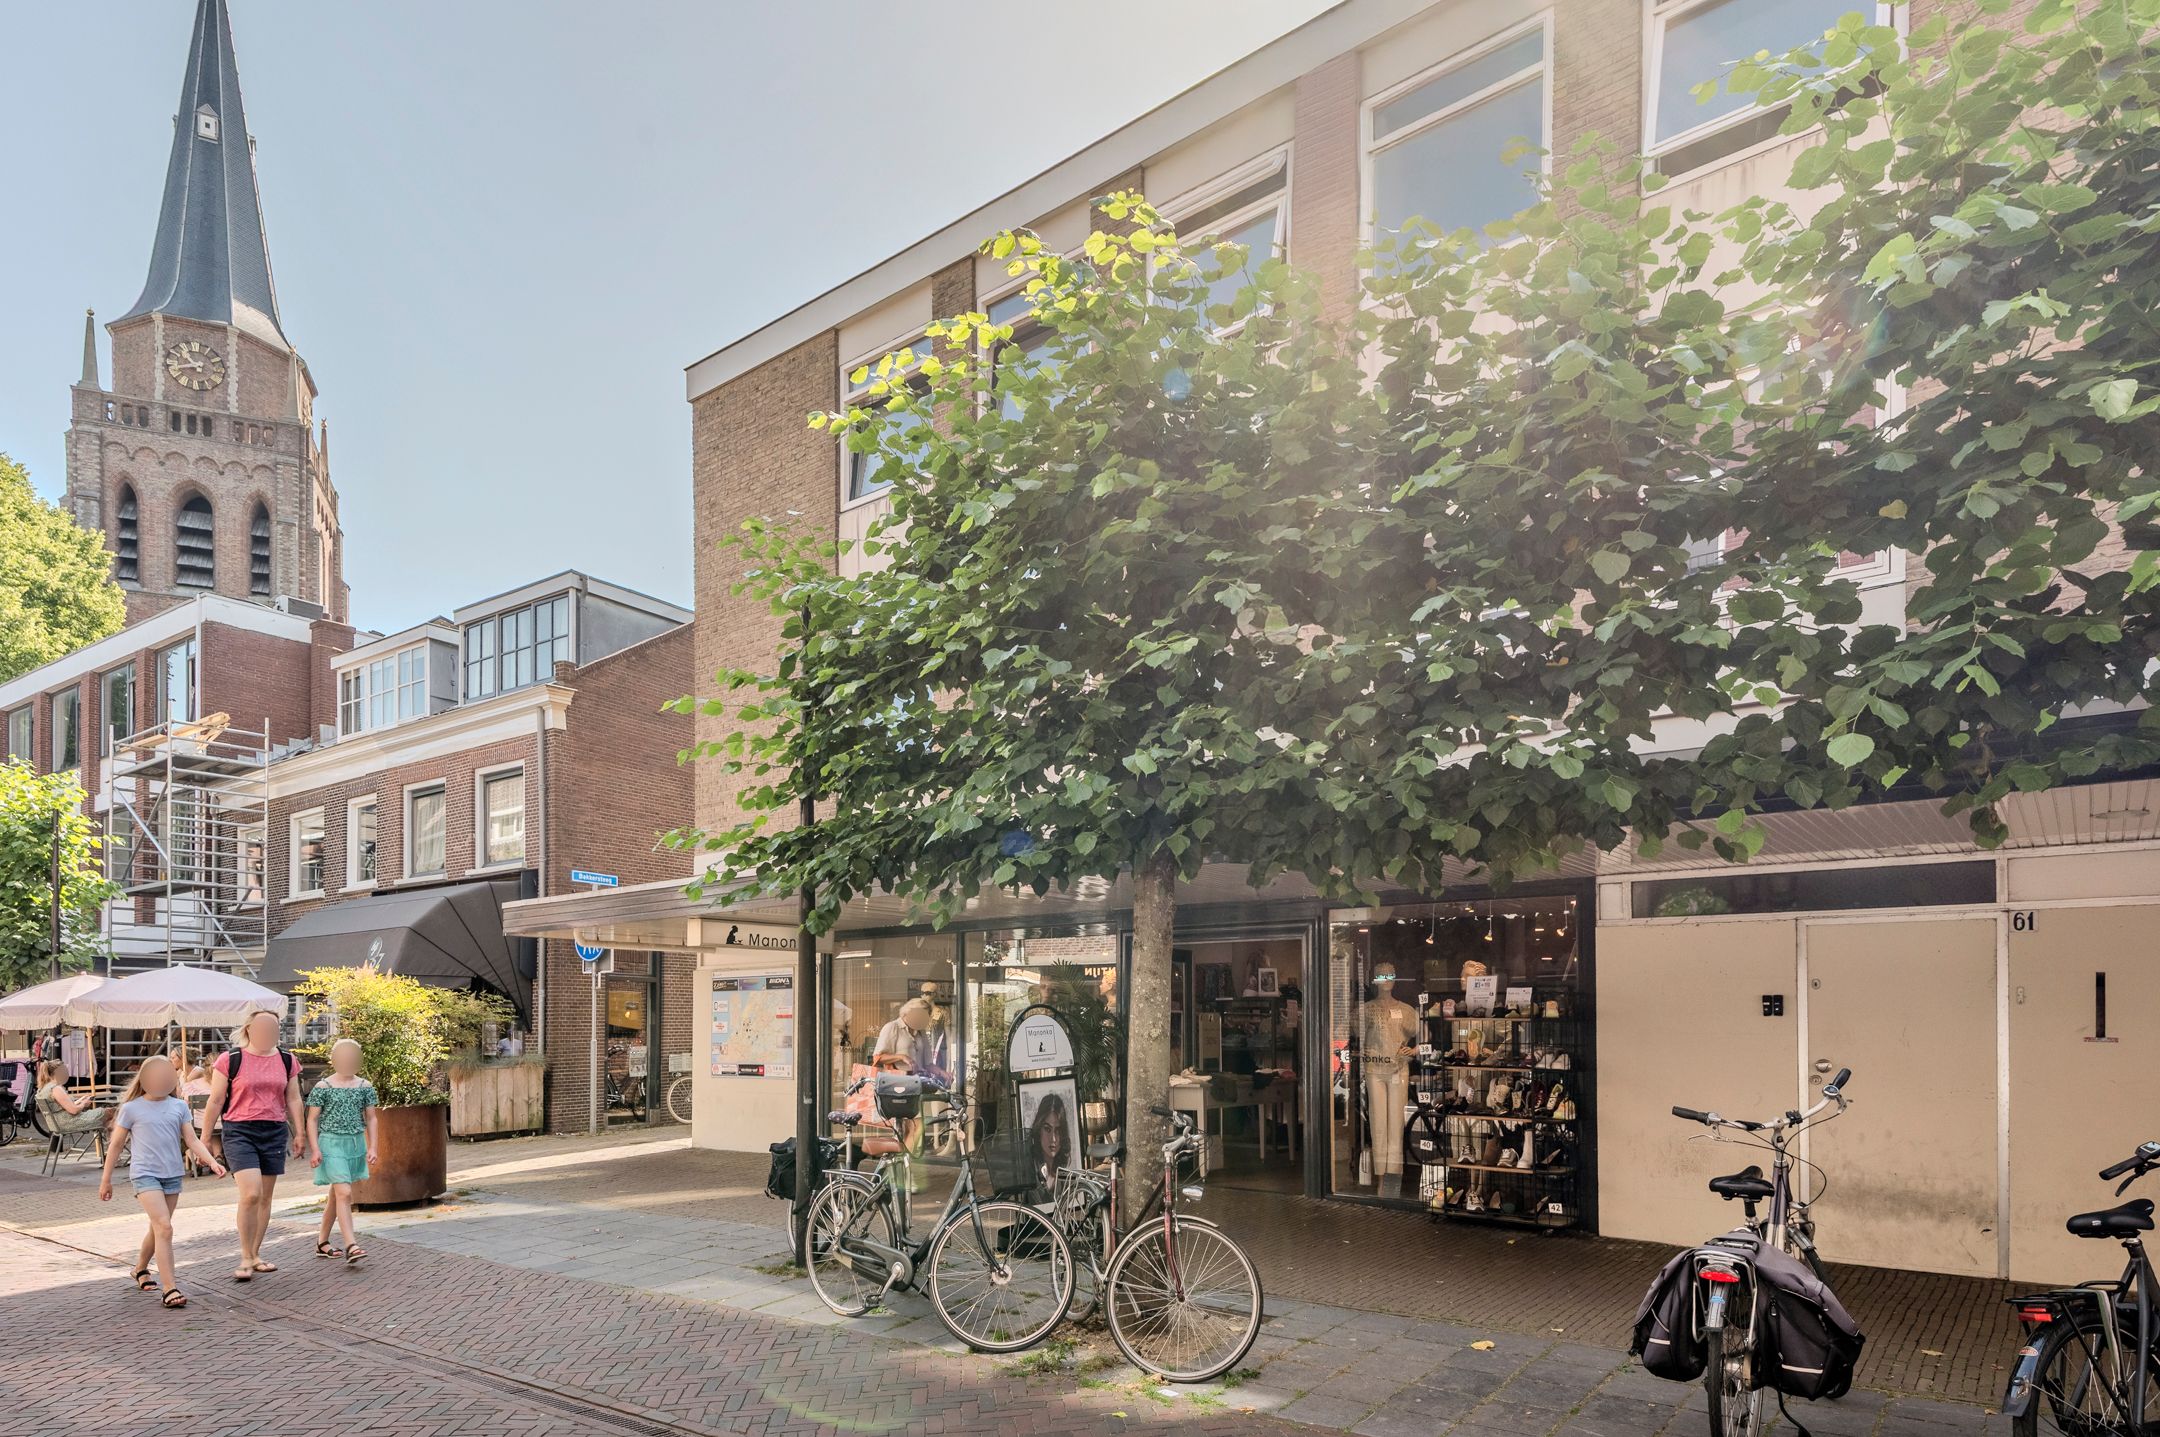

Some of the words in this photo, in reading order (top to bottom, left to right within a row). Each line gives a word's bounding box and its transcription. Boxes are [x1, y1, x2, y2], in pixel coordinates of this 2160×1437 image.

[2013, 911, 2034, 931] 61
[1420, 995, 1428, 1003] 36
[1027, 1029, 1053, 1037] Manonka
[1421, 1141, 1431, 1149] 40
[1550, 1204, 1561, 1212] 42
